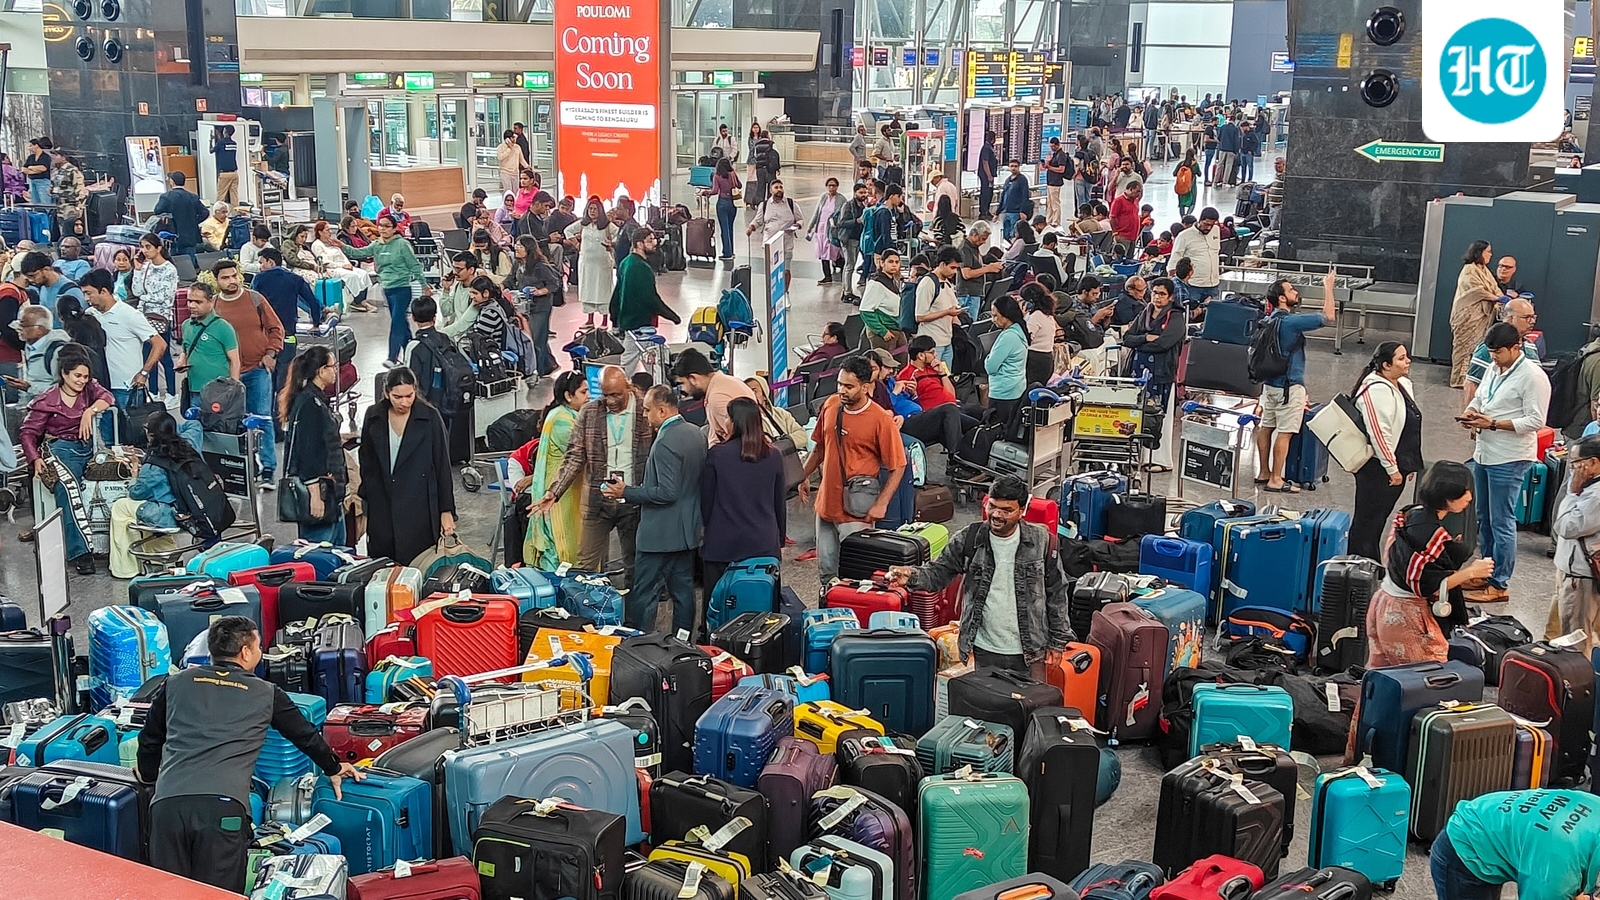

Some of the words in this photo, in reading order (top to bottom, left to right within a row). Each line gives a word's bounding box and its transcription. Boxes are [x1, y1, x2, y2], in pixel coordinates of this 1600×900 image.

[576, 6, 630, 18] POULOMI
[562, 26, 650, 64] Coming
[395, 74, 404, 88] 4
[516, 74, 522, 86] 3
[576, 62, 634, 90] Soon
[1375, 147, 1422, 156] EMERGENCY
[1423, 148, 1440, 157] EXIT
[1518, 791, 1550, 813] help
[1539, 795, 1571, 820] May
[1534, 822, 1549, 831] I
[1561, 803, 1592, 834] How
